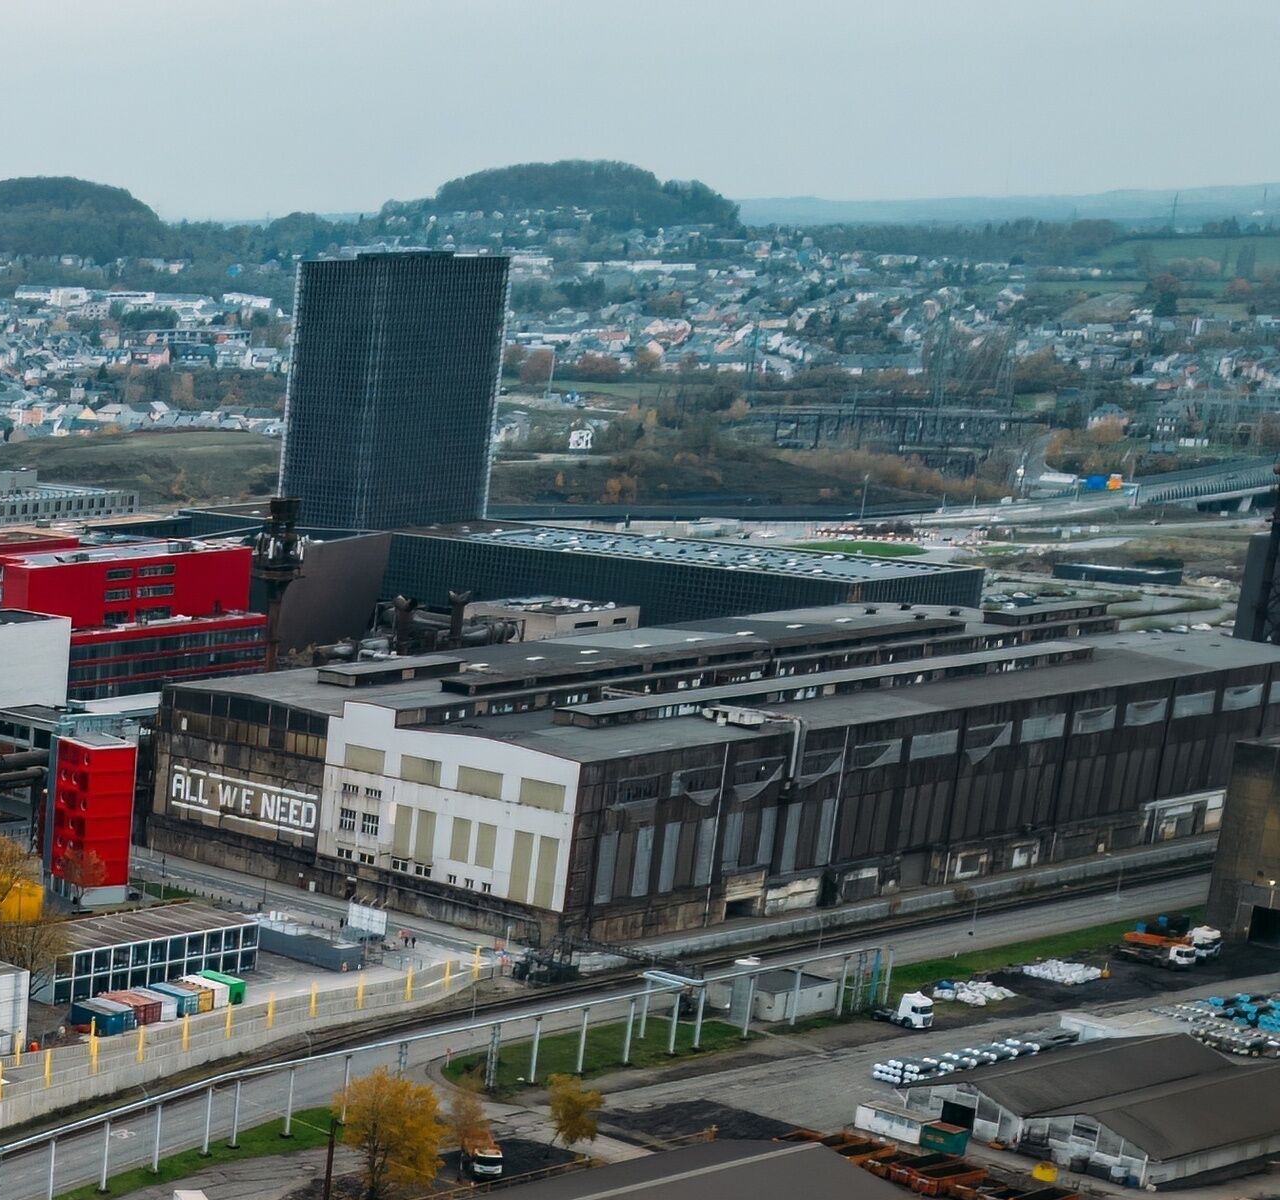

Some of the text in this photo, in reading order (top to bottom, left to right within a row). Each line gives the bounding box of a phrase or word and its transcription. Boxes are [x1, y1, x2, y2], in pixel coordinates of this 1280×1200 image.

[172, 773, 317, 829] ALL WE NEED
